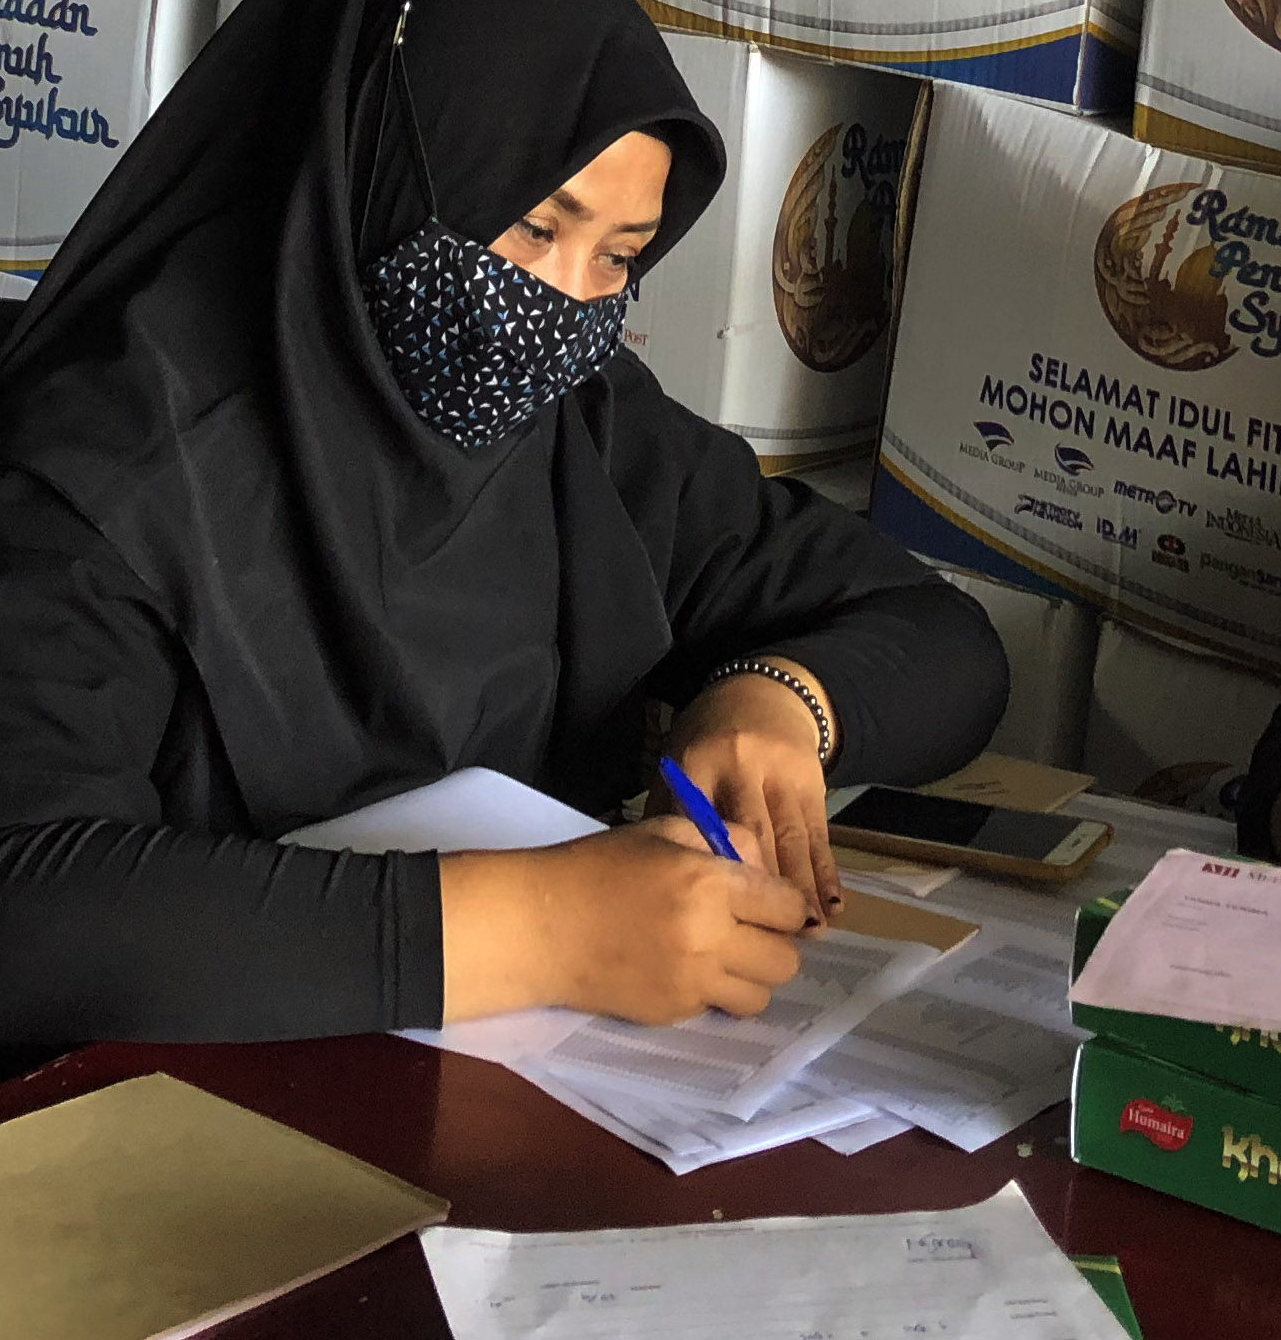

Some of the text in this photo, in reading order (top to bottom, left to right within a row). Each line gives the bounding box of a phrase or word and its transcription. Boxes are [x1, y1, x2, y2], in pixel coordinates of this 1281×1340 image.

[979, 375, 1094, 440] MOHON
[1104, 418, 1196, 469] MAAF
[1028, 352, 1161, 419] SELAMAT
[1168, 395, 1235, 443] IDUL
[1129, 1108, 1185, 1139] Humaira
